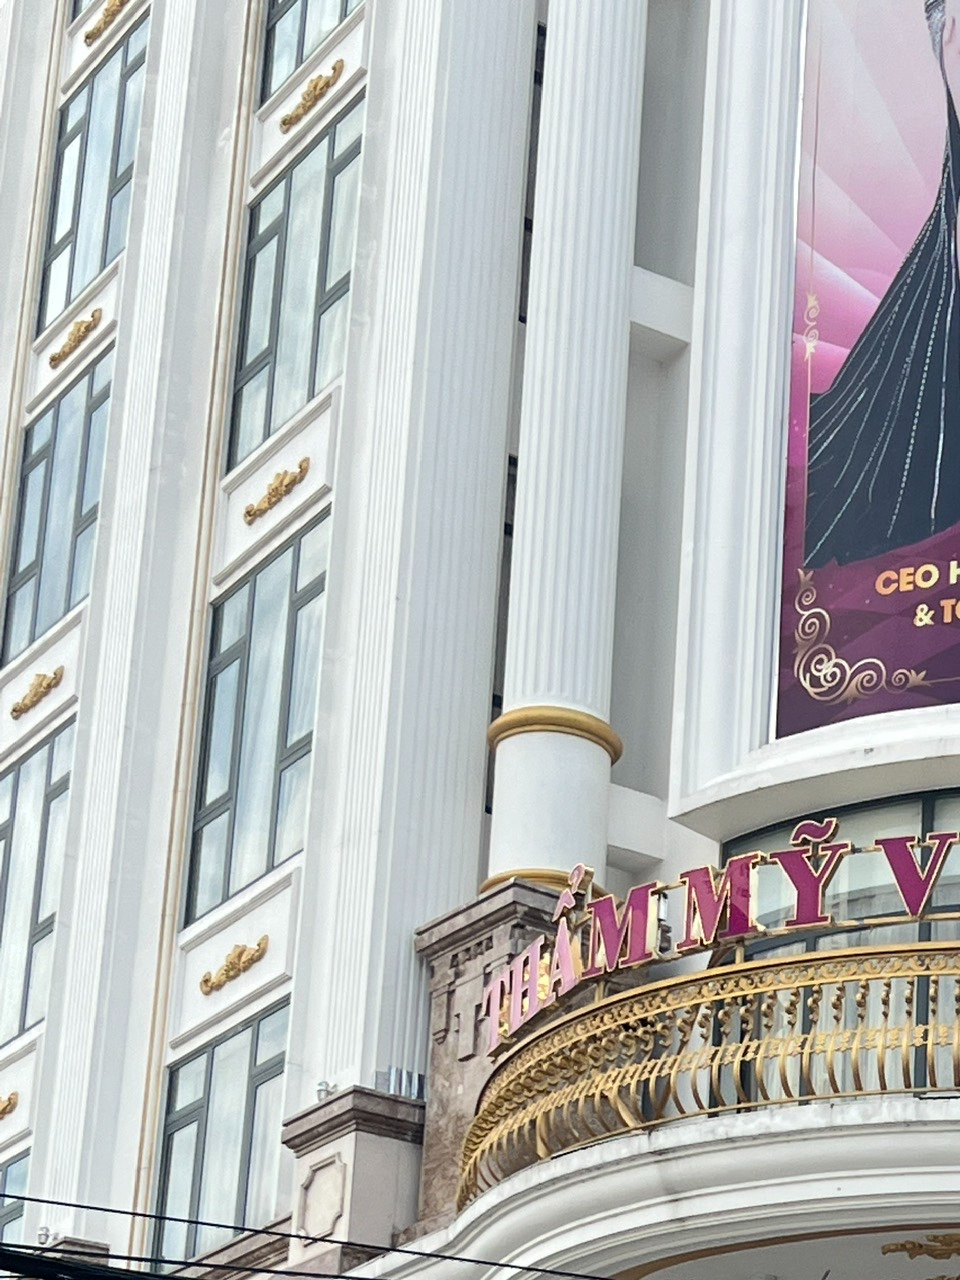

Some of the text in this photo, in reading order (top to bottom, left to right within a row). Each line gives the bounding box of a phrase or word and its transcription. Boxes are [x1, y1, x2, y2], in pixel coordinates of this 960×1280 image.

[875, 563, 940, 596] CEO
[913, 603, 935, 627] &
[478, 863, 658, 1057] THẨM
[676, 818, 851, 953] MỸ
